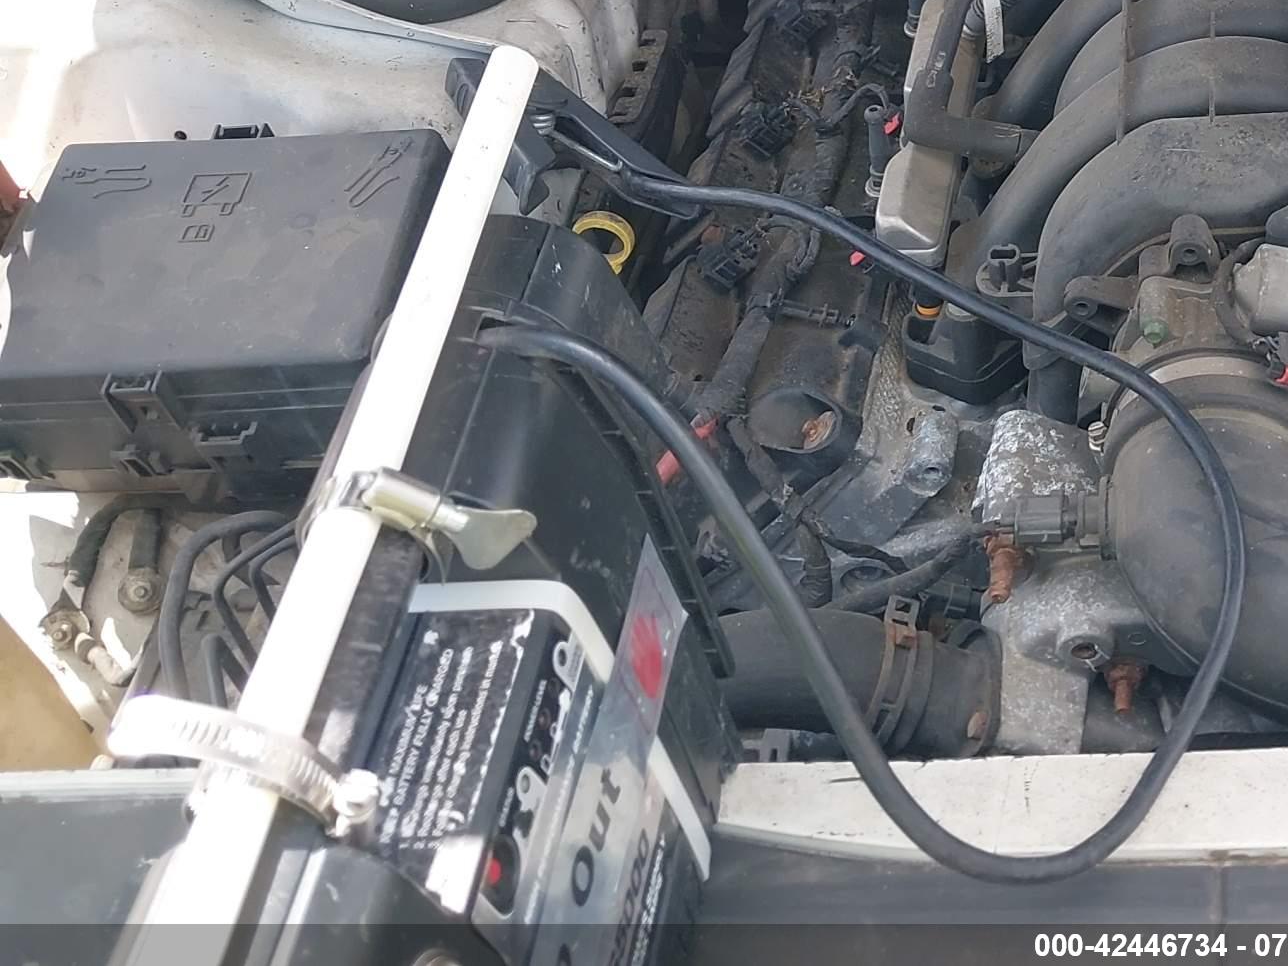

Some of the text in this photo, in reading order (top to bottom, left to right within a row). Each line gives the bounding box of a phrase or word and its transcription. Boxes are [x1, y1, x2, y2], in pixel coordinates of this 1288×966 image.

[393, 747, 419, 806] BATTERY
[413, 708, 433, 747] FULLY
[425, 649, 454, 708] CHARGED
[446, 729, 460, 756] each
[460, 690, 488, 751] instructions
[571, 768, 621, 907] Out
